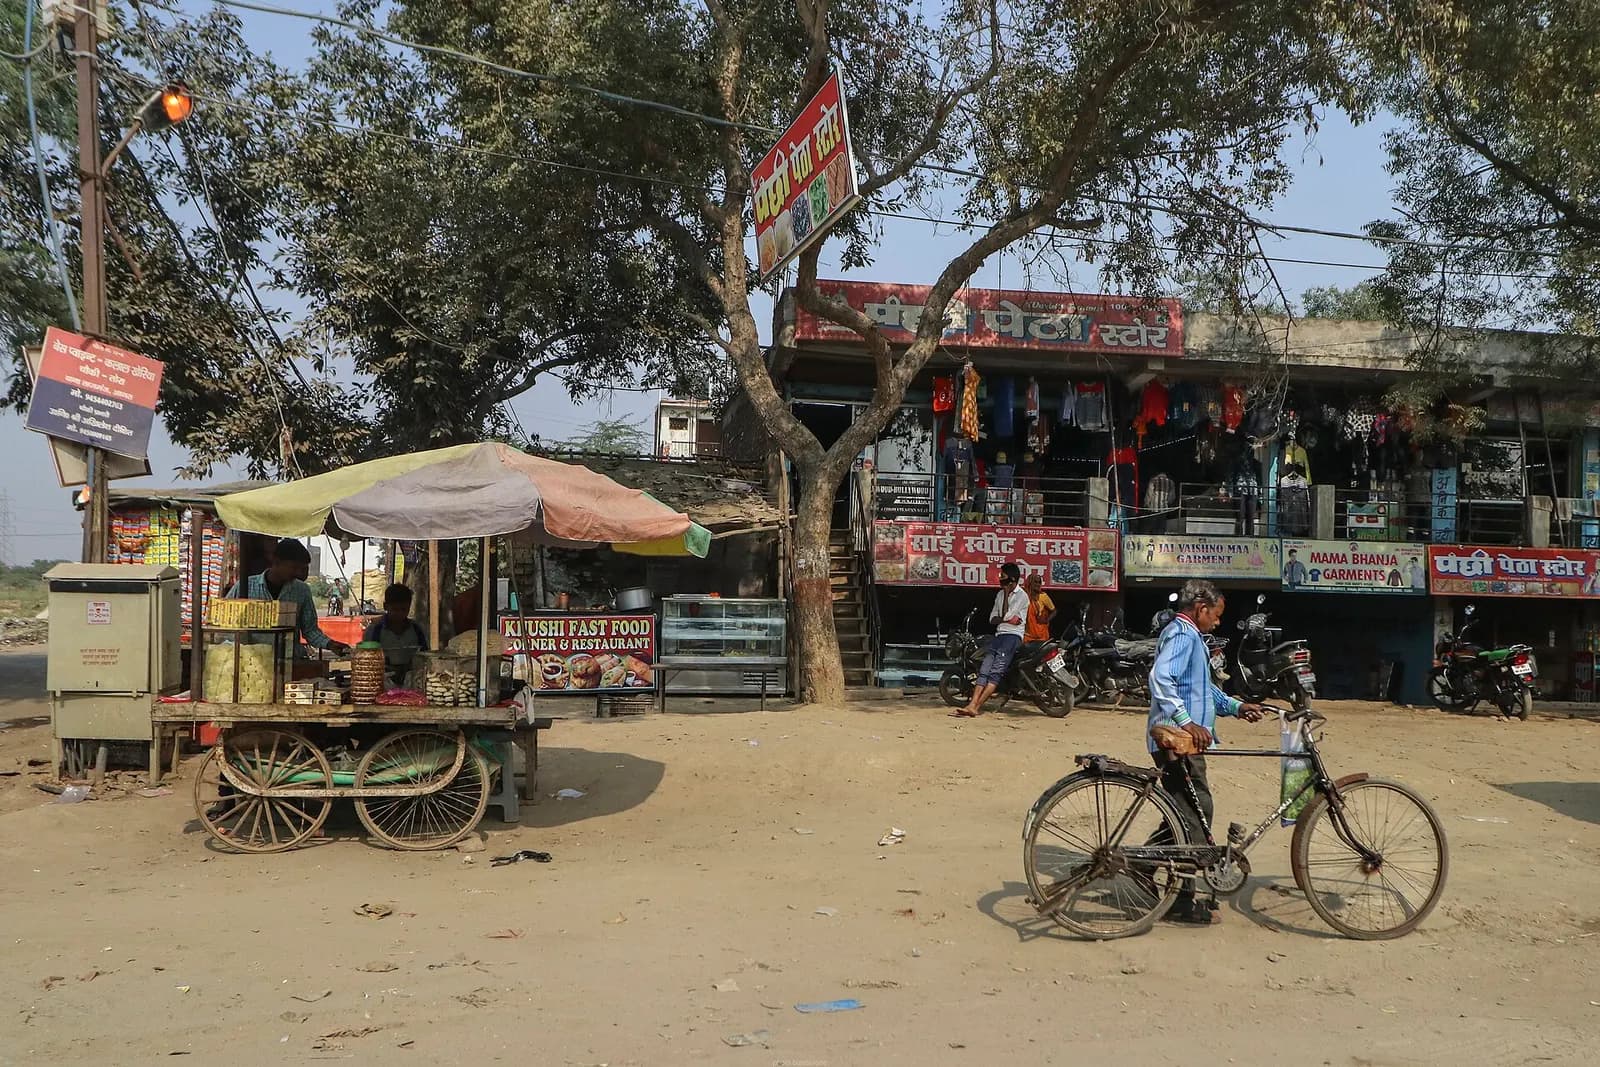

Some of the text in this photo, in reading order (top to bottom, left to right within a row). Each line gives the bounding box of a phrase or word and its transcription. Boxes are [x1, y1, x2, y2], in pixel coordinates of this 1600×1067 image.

[812, 102, 842, 162] स्टोर
[980, 300, 1088, 342] पेठा
[1099, 317, 1169, 349] स्टोर
[963, 532, 1017, 554] स्वीट
[1023, 537, 1084, 557] हाउस
[1158, 543, 1250, 555] JAI VAISHNO MAA
[1176, 554, 1233, 564] GARMENT
[1310, 552, 1398, 566] MAMA BHANJA
[1434, 549, 1586, 577] पंछी पेठा स्टोर
[943, 557, 990, 585] पेठा
[1323, 568, 1386, 581] GARMENTS
[568, 619, 609, 637] FAST
[611, 618, 651, 636] FOOD
[559, 638, 569, 651] &
[571, 637, 651, 650] RESTAURANT
